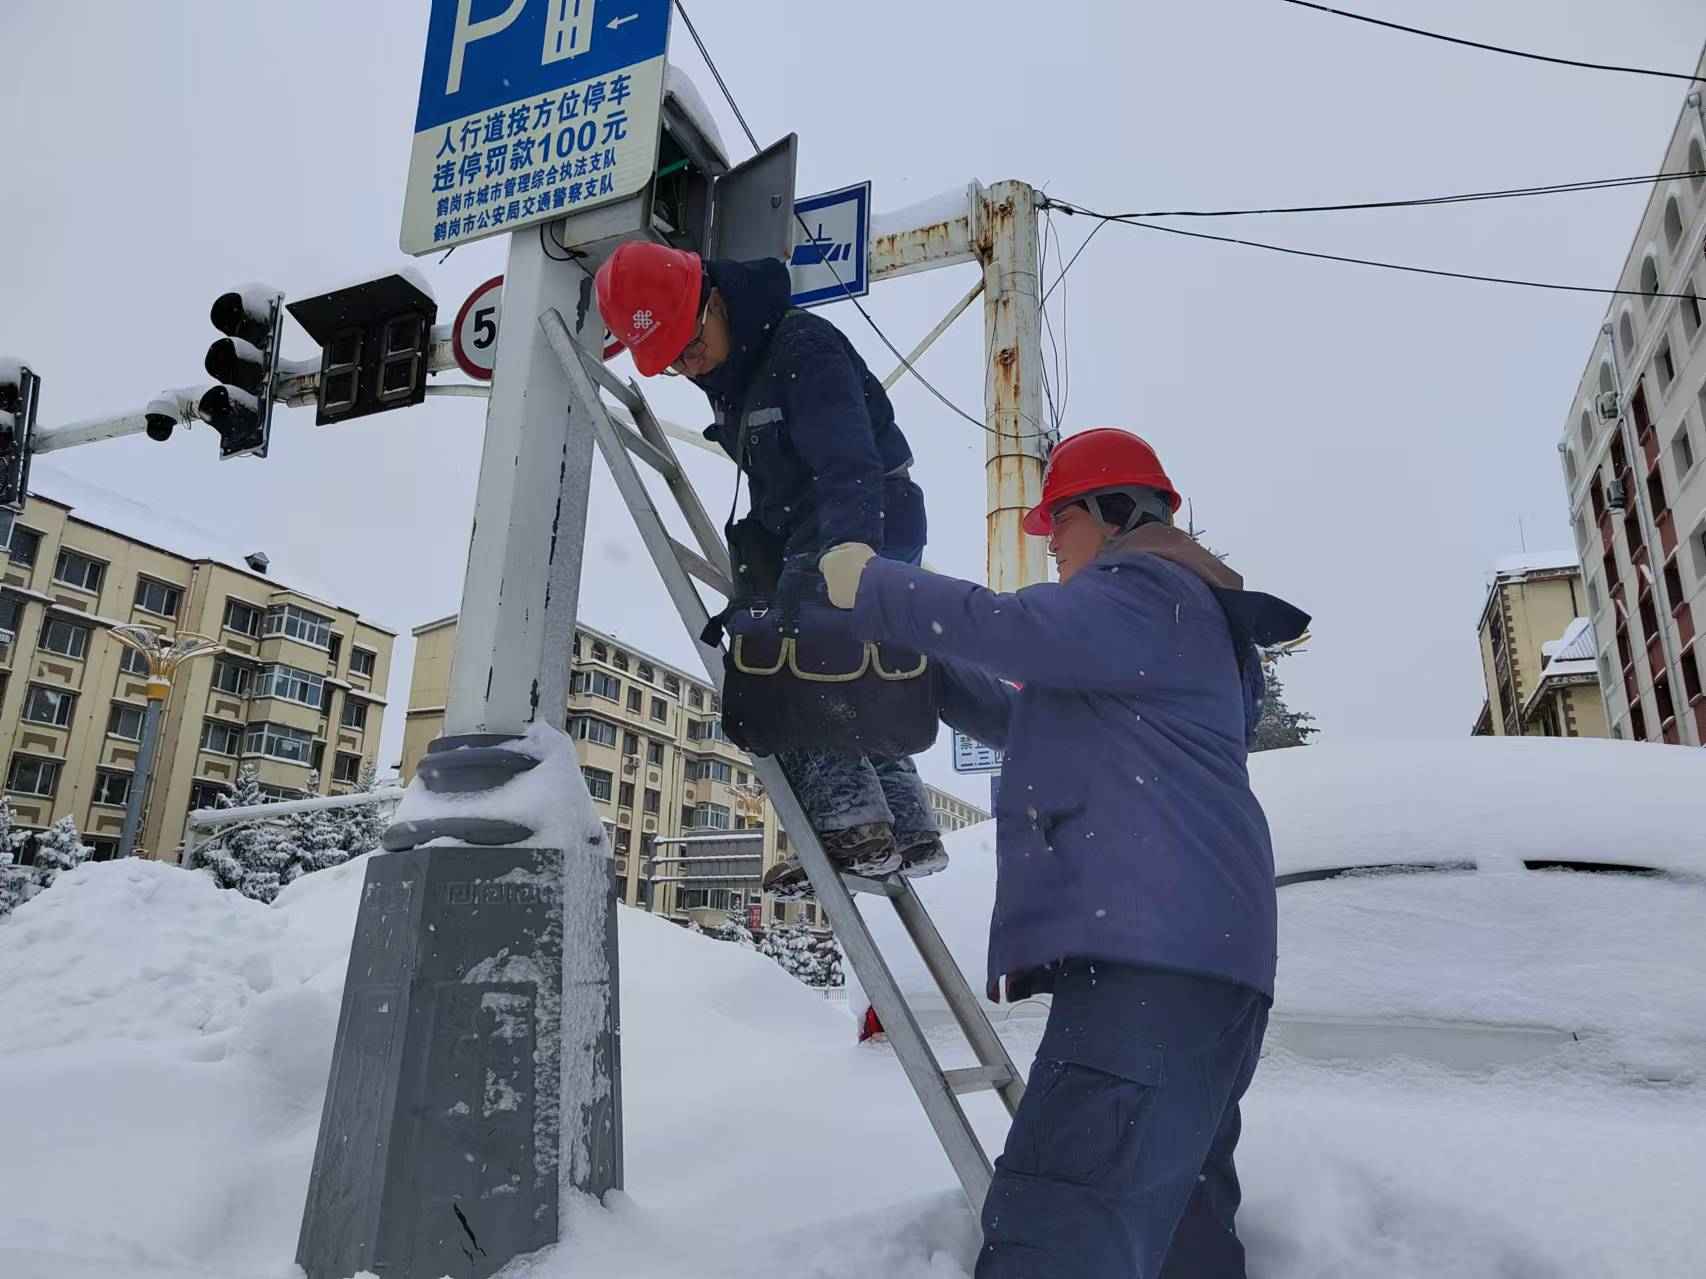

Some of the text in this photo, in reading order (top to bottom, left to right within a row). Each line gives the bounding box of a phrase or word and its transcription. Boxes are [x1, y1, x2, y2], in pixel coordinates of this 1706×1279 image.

[445, 0, 528, 96] P
[432, 110, 628, 194] 违停罚款100元
[436, 74, 631, 159] 人行道按方位停车
[433, 172, 615, 243] 鹤岗市公安局交通警察支队
[436, 147, 617, 217] 鹤岗市城市管理综合执法支队
[473, 306, 497, 349] 5
